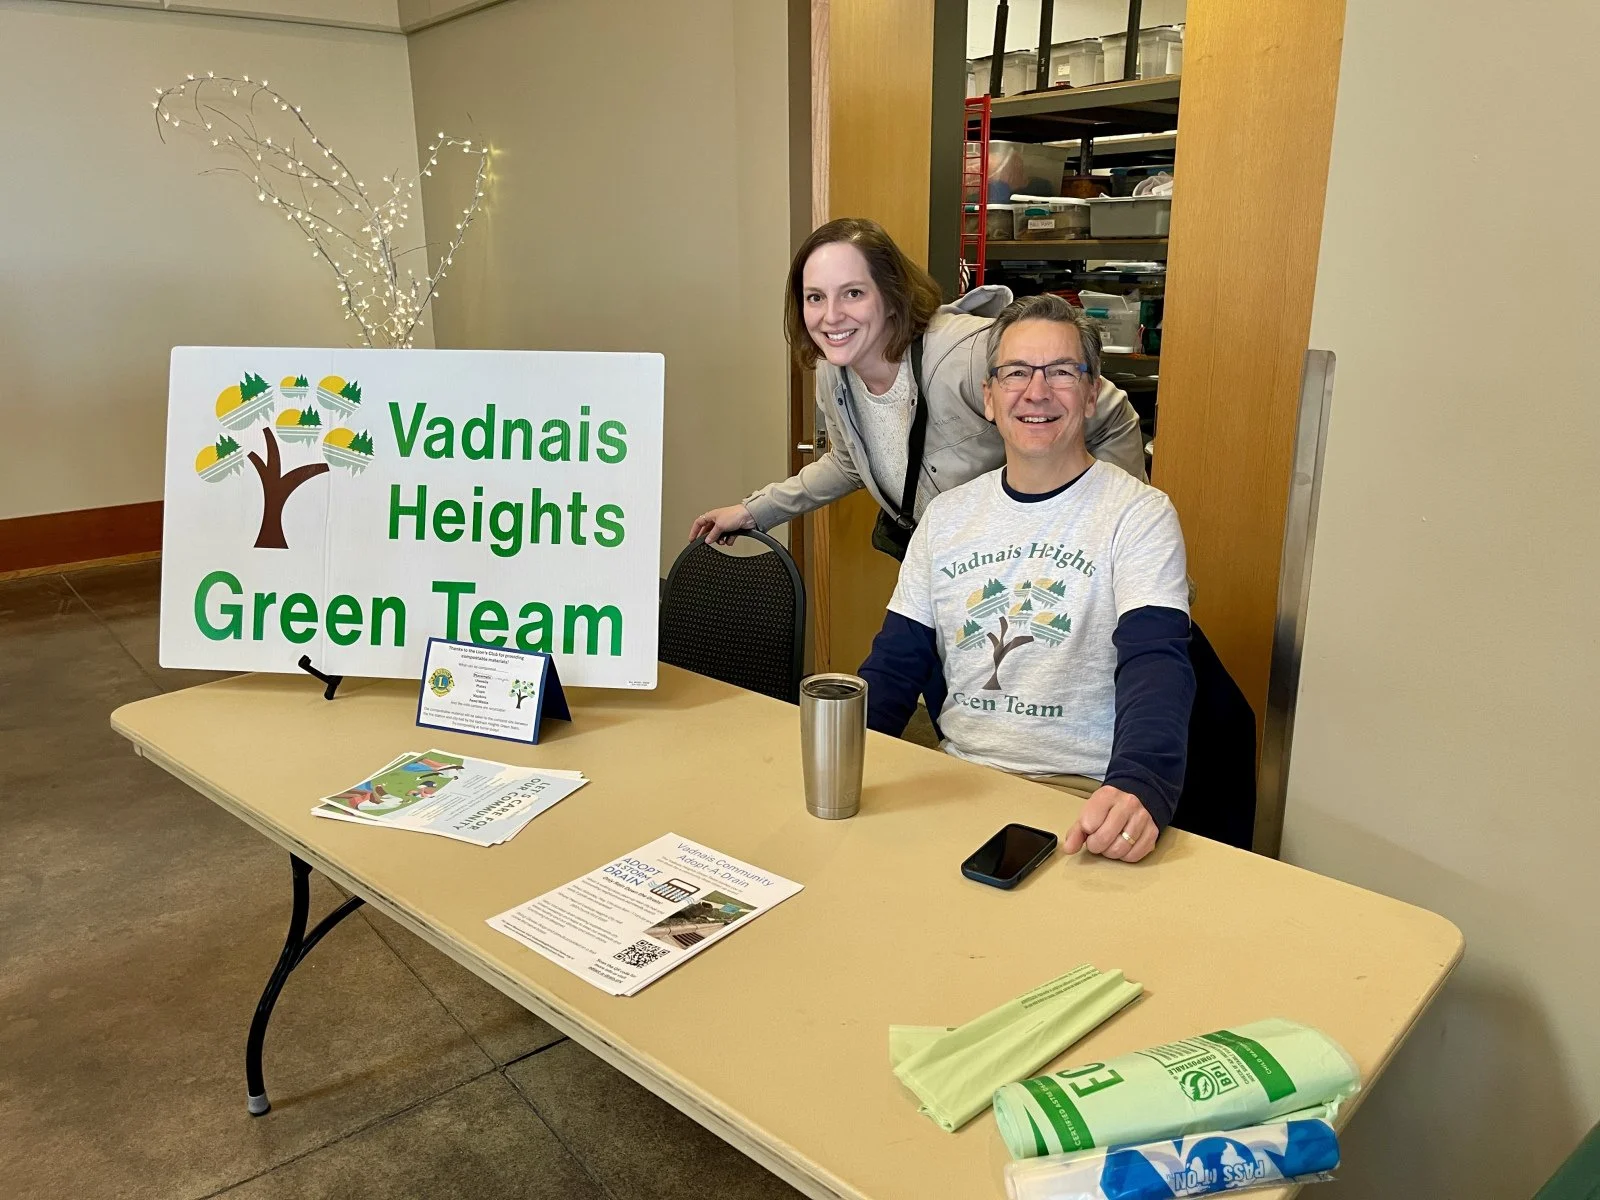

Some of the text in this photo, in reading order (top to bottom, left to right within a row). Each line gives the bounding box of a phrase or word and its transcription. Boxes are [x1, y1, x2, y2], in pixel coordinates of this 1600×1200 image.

[388, 402, 628, 464] Vadnais
[389, 484, 626, 558] Heights
[940, 542, 1097, 580] Vadnais Heights
[194, 571, 623, 656] Green Team
[438, 676, 445, 688] L
[953, 692, 1064, 718] Gen Team
[517, 778, 541, 791] OUR
[521, 782, 551, 799] LET'S
[453, 791, 518, 831] COMMUNITY
[492, 799, 522, 817] CARE
[470, 816, 494, 830] FOR
[621, 865, 653, 881] STORM
[623, 857, 663, 876] ADOPT
[677, 842, 716, 863] Vadnais
[715, 859, 775, 887] Community
[678, 854, 750, 888] Adopt-A-Drain
[603, 866, 645, 886] DRAIN
[1168, 1053, 1217, 1075] COMPOSTABLE
[1257, 1058, 1272, 1075] CHILD
[1211, 1065, 1232, 1087] BPI
[1046, 1091, 1062, 1108] ASTM
[1058, 1108, 1081, 1147] CERTIFIED
[1174, 1169, 1198, 1191] ON
[1222, 1160, 1265, 1182] PASS
